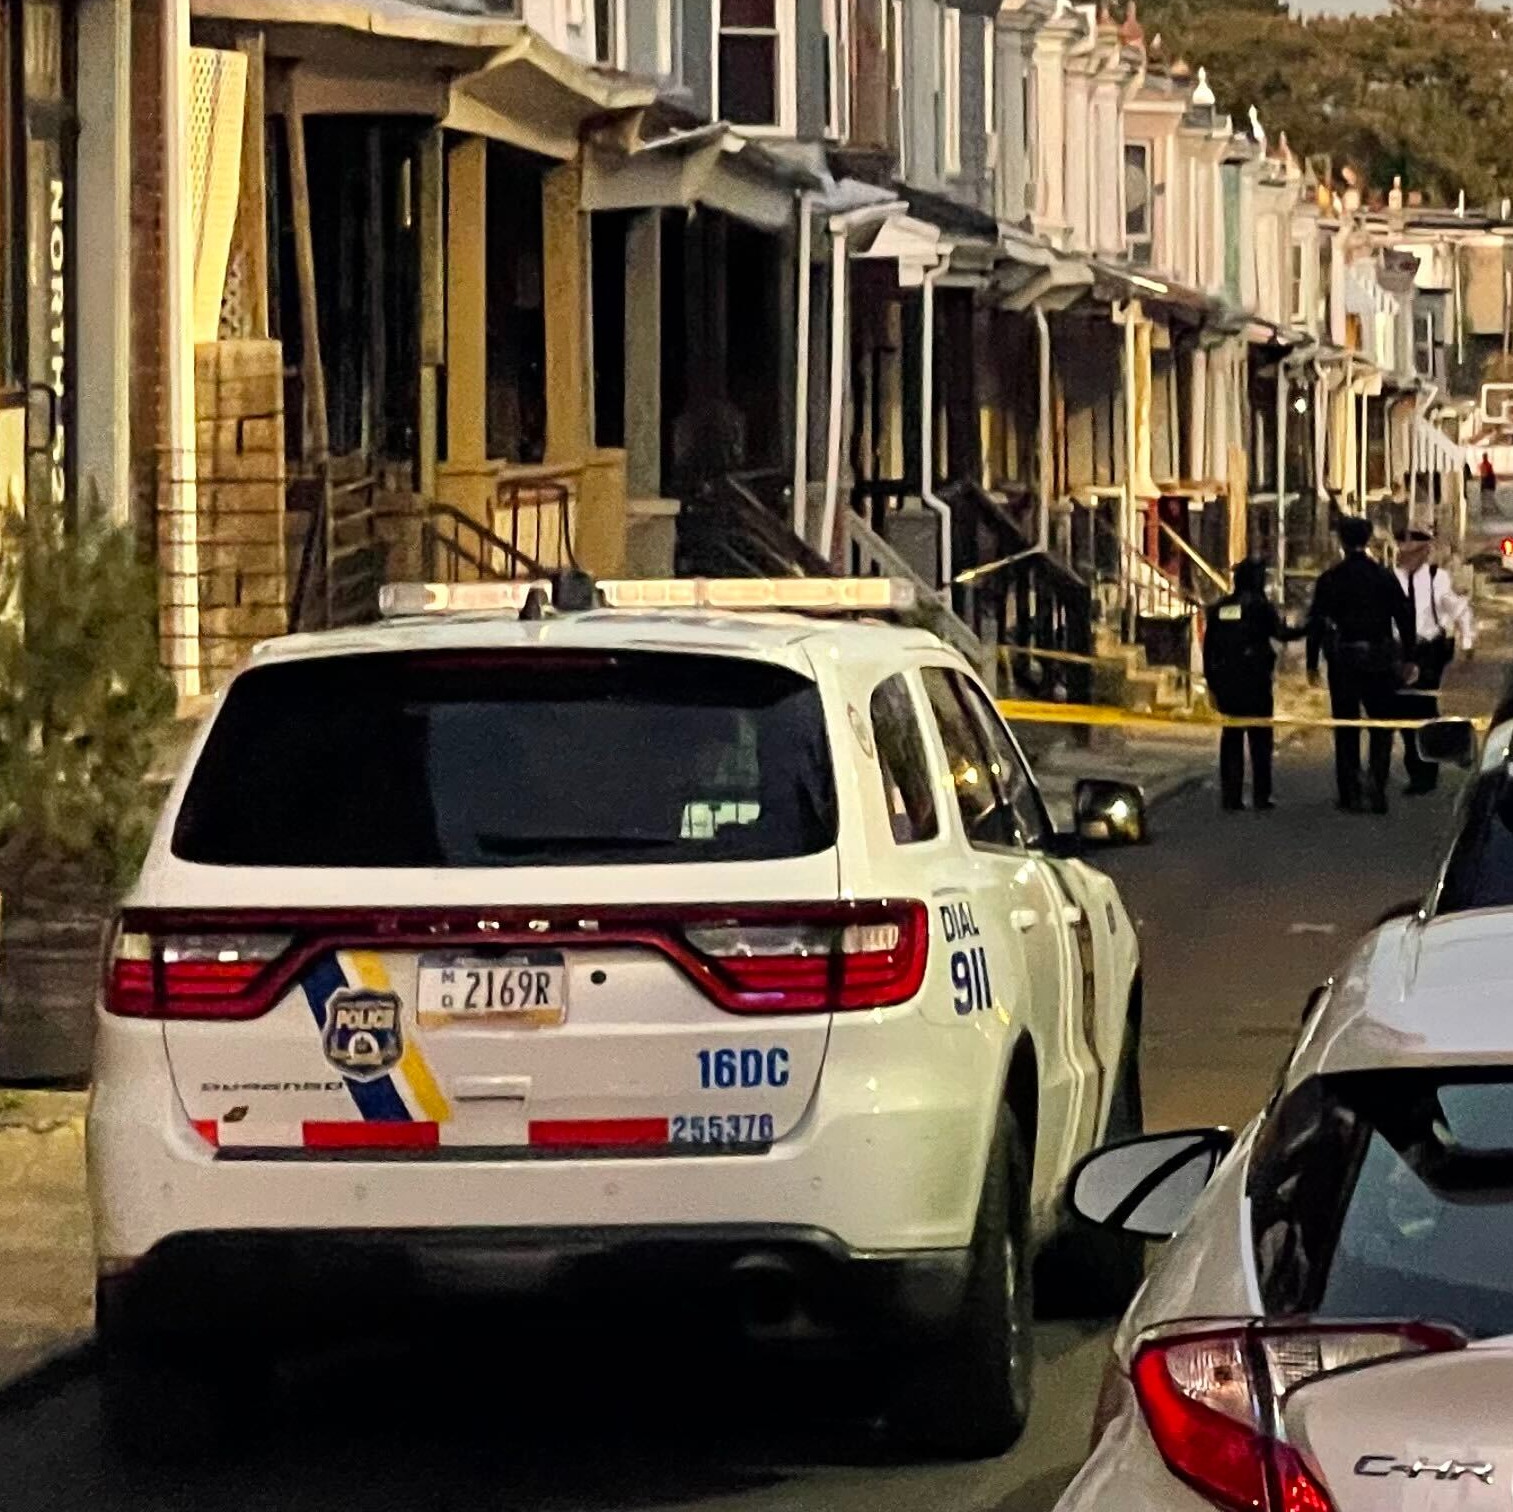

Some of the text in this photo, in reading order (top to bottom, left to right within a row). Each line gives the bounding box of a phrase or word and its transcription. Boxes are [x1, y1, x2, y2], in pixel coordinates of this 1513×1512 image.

[50, 180, 64, 397] NORTH
[939, 901, 980, 943] DIAL
[464, 969, 550, 1009] 2169R
[951, 946, 992, 1016] 911
[697, 1047, 789, 1088] 16DC
